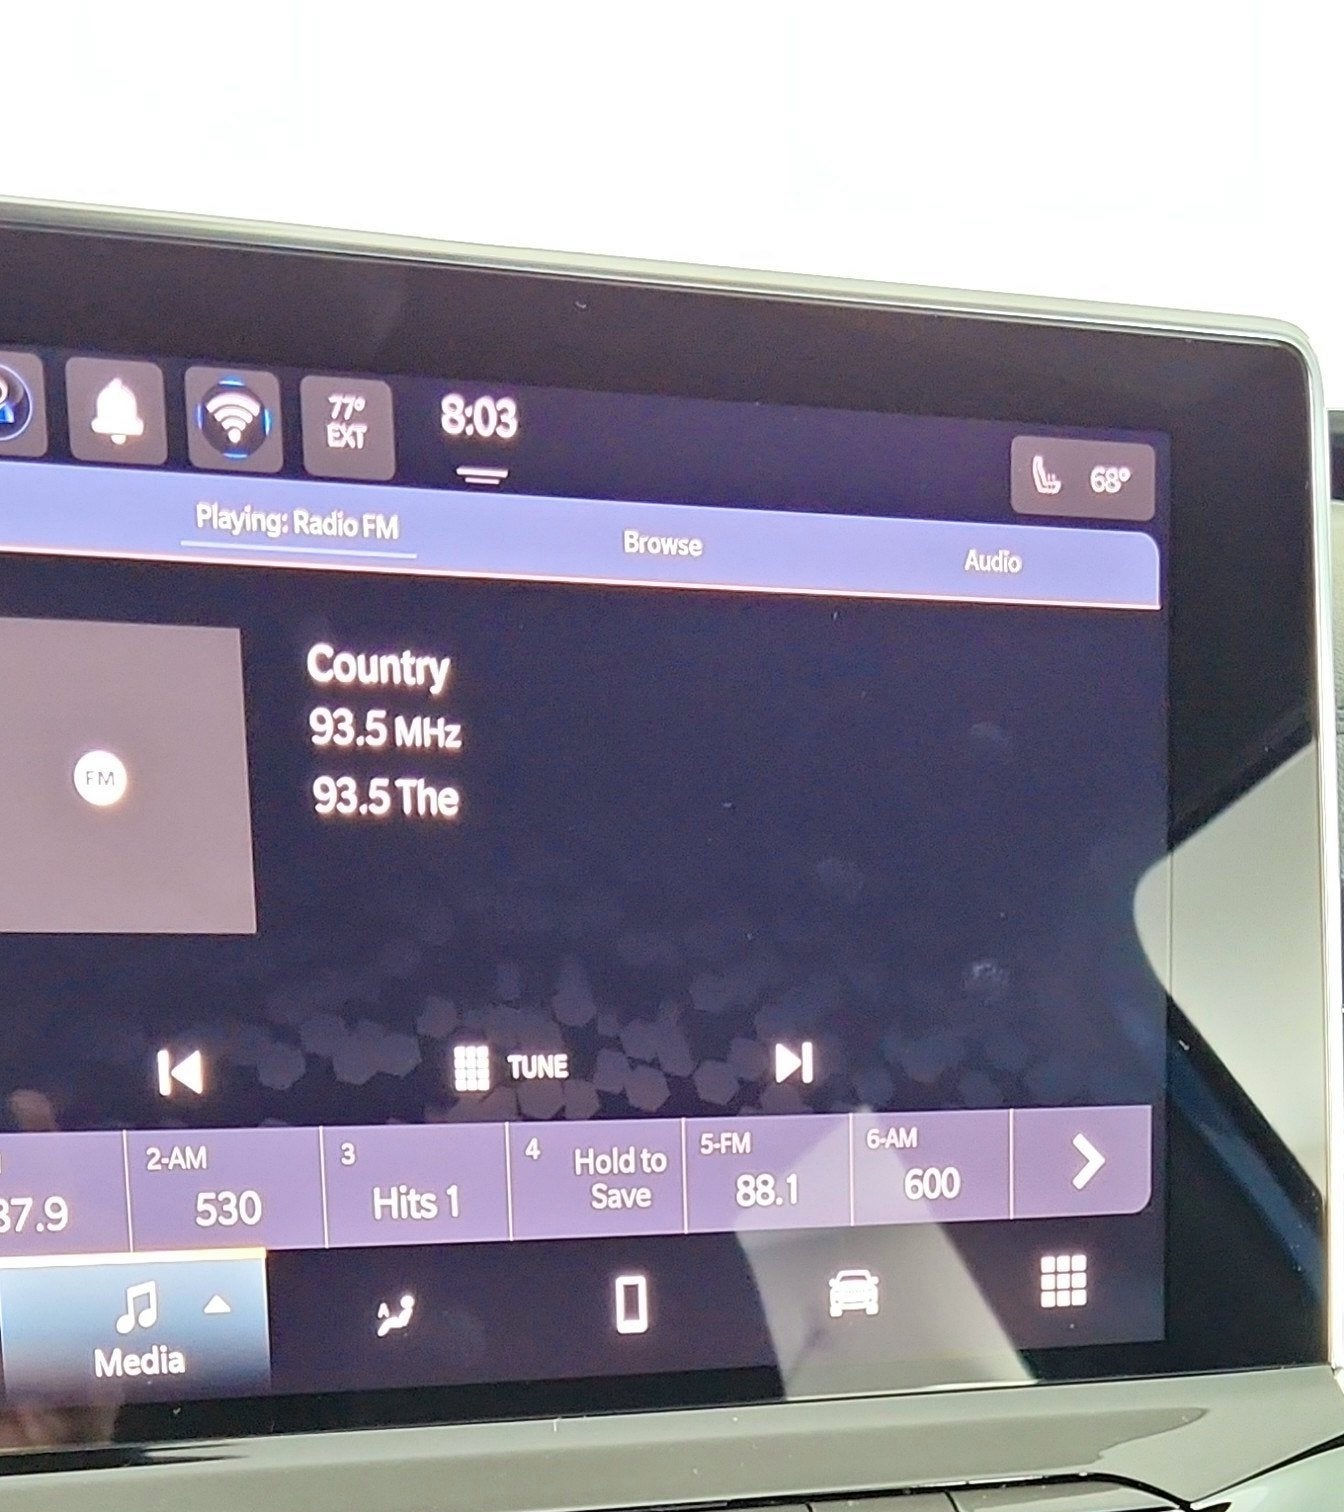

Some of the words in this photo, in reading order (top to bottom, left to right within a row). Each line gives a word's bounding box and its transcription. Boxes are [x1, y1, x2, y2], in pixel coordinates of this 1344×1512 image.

[441, 394, 518, 438] 8:03
[326, 422, 367, 450] EXT
[196, 501, 290, 538] Playing:
[293, 507, 358, 536] Radio
[363, 513, 399, 541] FM
[623, 529, 703, 557] Browse
[964, 549, 1022, 574] Audio
[306, 642, 450, 694] Country
[309, 708, 388, 747] 93.5
[394, 717, 462, 749] MHz
[85, 770, 116, 787] FM
[312, 777, 392, 816] 93.5
[395, 778, 460, 817] The
[507, 1053, 569, 1079] TUNE
[525, 1138, 540, 1159] 4
[700, 1131, 751, 1155] 5-FM
[866, 1127, 918, 1149] 6-AM
[146, 1145, 208, 1171] 2-AM
[341, 1144, 355, 1165] 3
[574, 1147, 634, 1175] Hold
[639, 1149, 667, 1174] to
[591, 1183, 651, 1209] Save
[736, 1173, 799, 1207] 88.1
[904, 1167, 960, 1201] 600
[195, 1190, 262, 1227] 530
[373, 1186, 439, 1220] Hits
[446, 1185, 460, 1217] 1
[94, 1346, 185, 1377] Media
